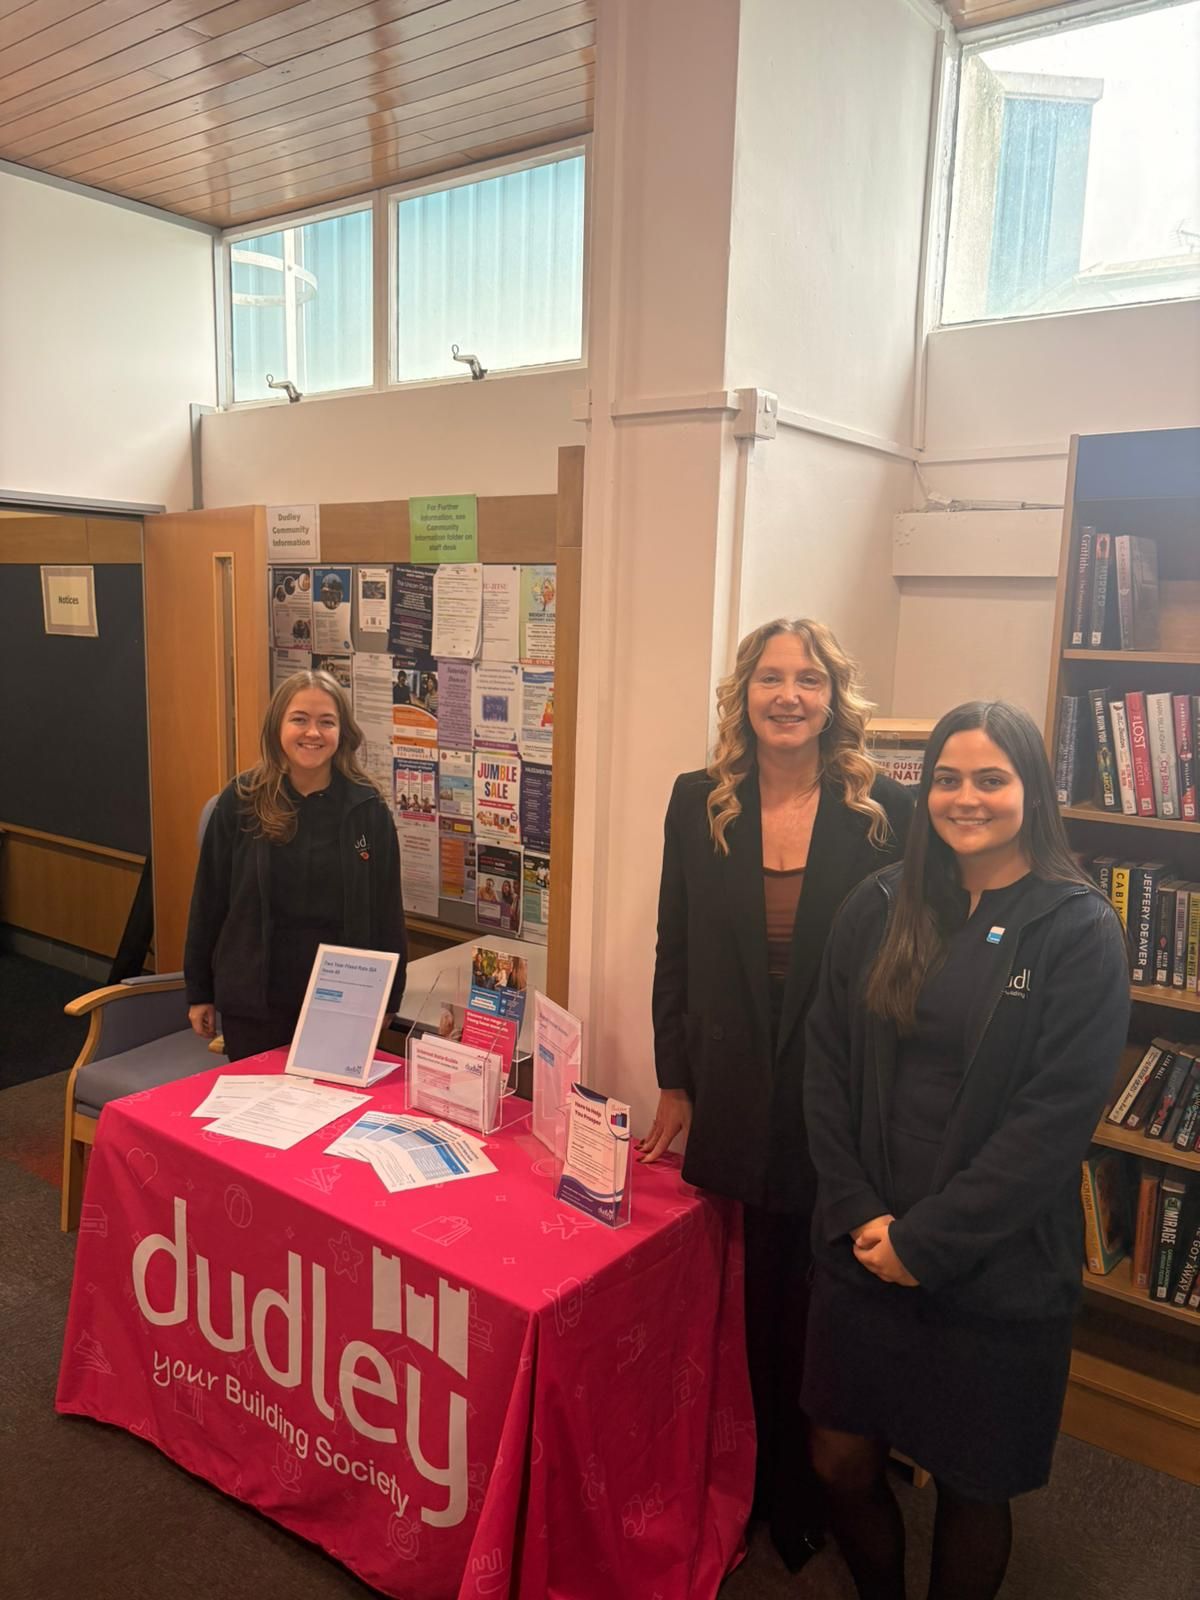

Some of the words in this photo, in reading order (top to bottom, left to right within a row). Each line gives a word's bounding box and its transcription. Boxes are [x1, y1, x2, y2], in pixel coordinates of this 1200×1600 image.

[278, 513, 301, 522] Dudley
[271, 525, 310, 535] Community
[58, 595, 80, 605] Notices
[1132, 720, 1147, 749] LOST
[477, 762, 518, 783] JUMBLE
[1160, 760, 1169, 774] Cry
[484, 781, 509, 800] SALE
[1161, 775, 1170, 795] Baby
[1141, 873, 1153, 920] JEFFERY
[1137, 923, 1150, 966] DEAVER
[583, 1113, 602, 1126] Prosper
[591, 1108, 602, 1118] Help
[1160, 1210, 1179, 1245] MIRAGE
[1189, 1240, 1200, 1262] GOT
[1177, 1263, 1193, 1291] AWAY
[132, 1196, 468, 1528] dudley
[154, 1350, 219, 1391] your
[225, 1373, 309, 1459] Building
[314, 1435, 410, 1518] Society
